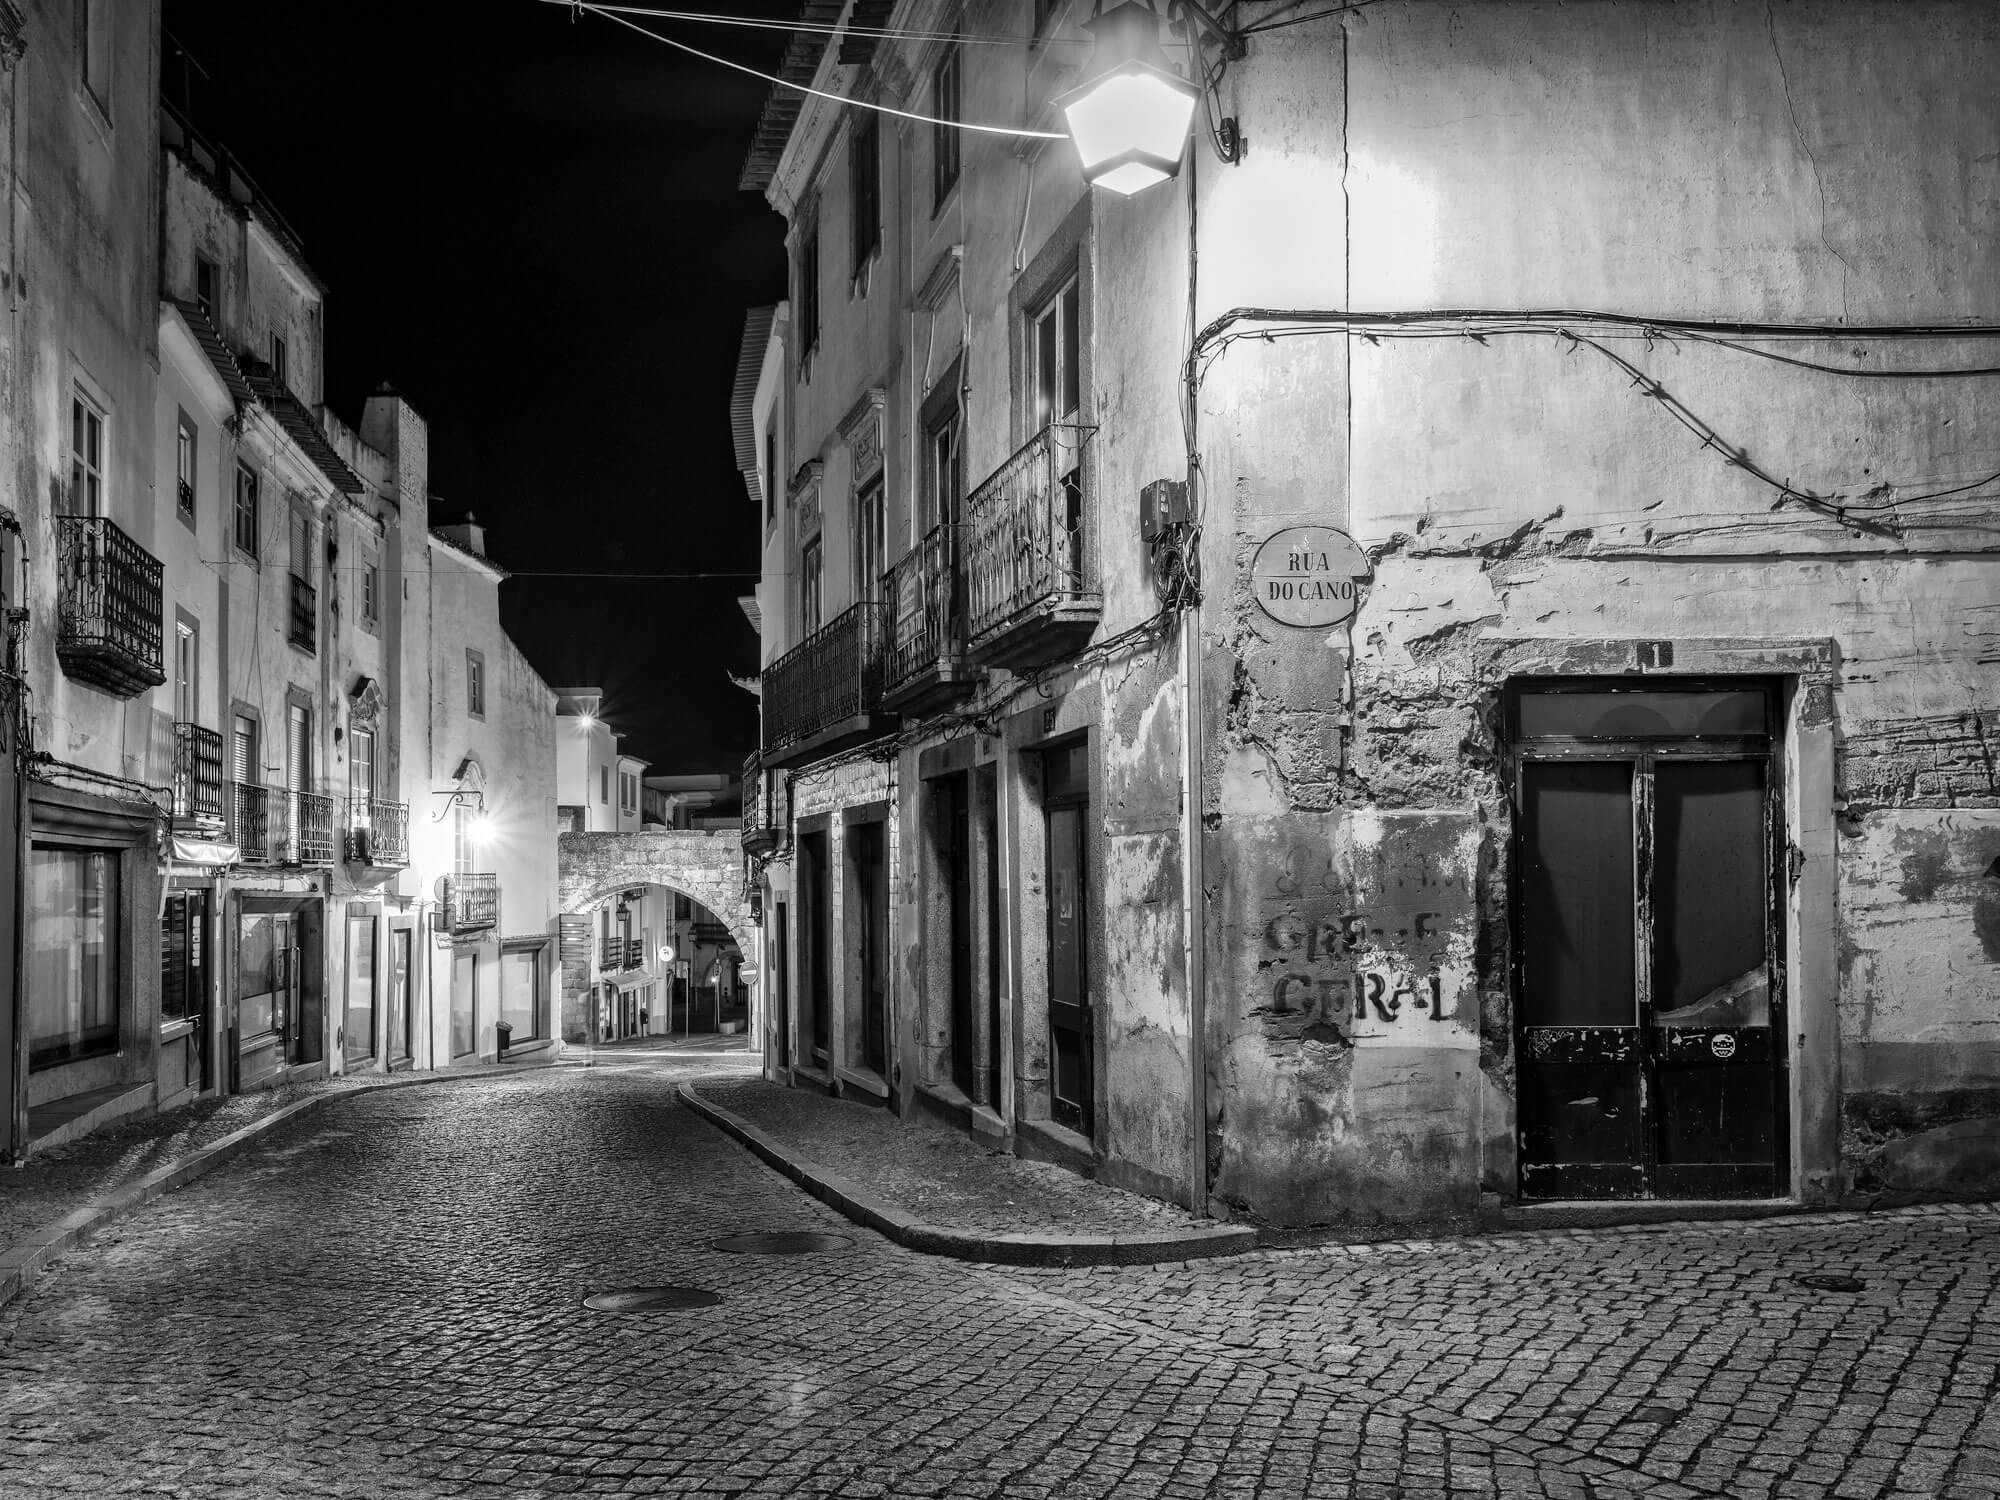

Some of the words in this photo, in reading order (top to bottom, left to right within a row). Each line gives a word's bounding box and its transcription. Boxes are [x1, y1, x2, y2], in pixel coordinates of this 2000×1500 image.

[1288, 552, 1330, 571] RUA
[1269, 581, 1293, 601] DO
[1299, 581, 1352, 600] CANO
[1652, 643, 1660, 668] 1
